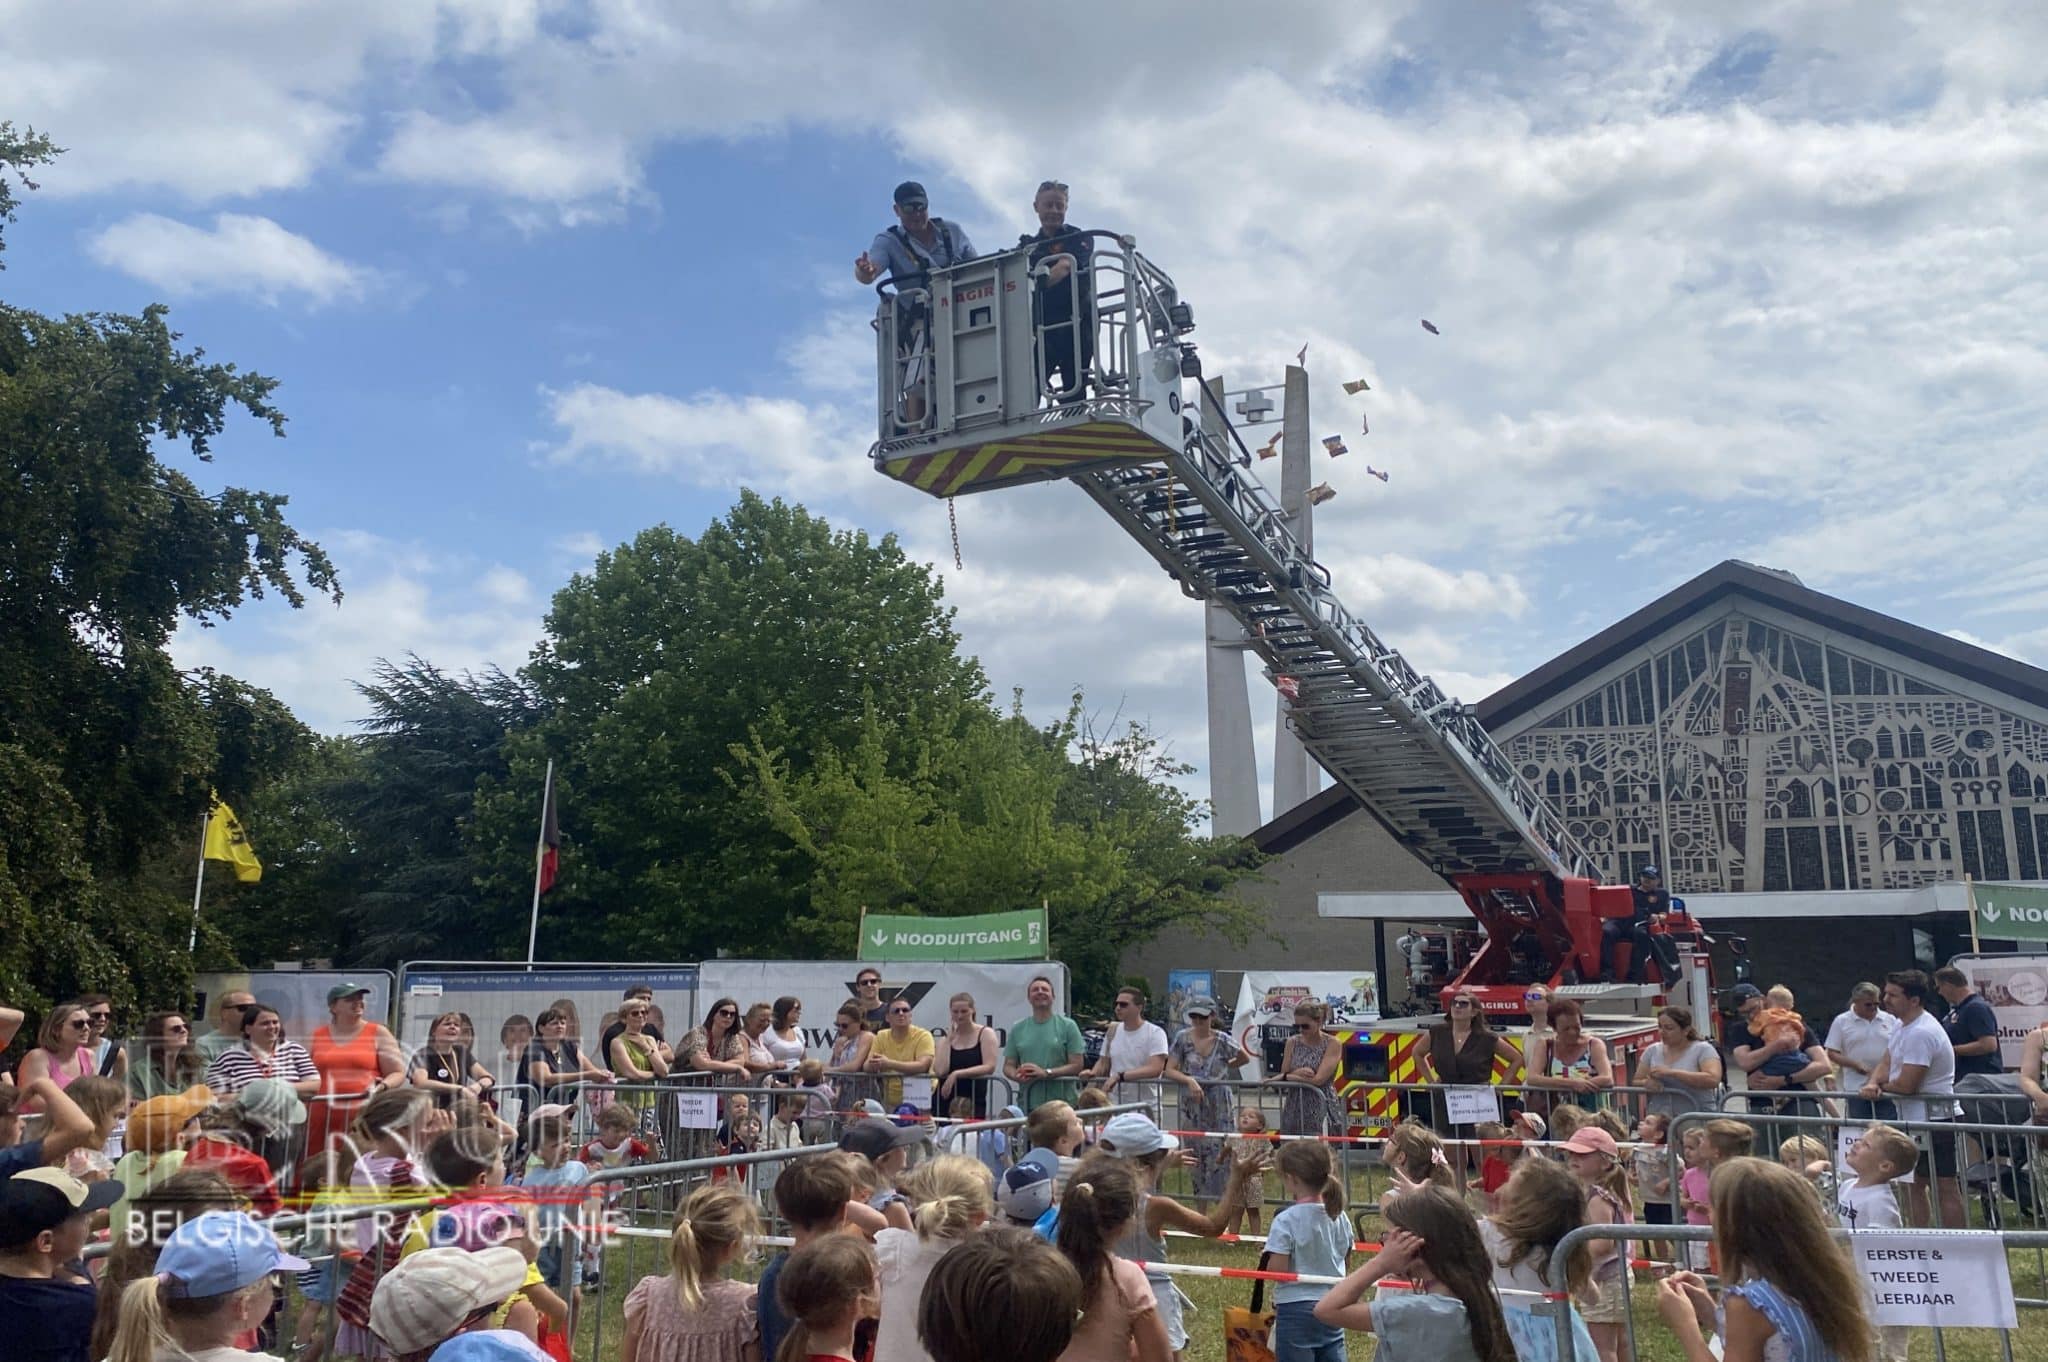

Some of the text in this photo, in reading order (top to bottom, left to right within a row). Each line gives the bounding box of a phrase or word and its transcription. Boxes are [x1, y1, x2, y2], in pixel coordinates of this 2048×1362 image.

[941, 280, 1016, 307] MAGIRS
[2009, 906, 2048, 922] NO
[894, 928, 1022, 946] NOODUITGANG
[1480, 1002, 1518, 1010] AGIRUS
[1867, 1249, 1943, 1261] EERSTE &
[1870, 1271, 1940, 1283] TWEEDE
[1874, 1293, 1956, 1305] LEERJAAR
